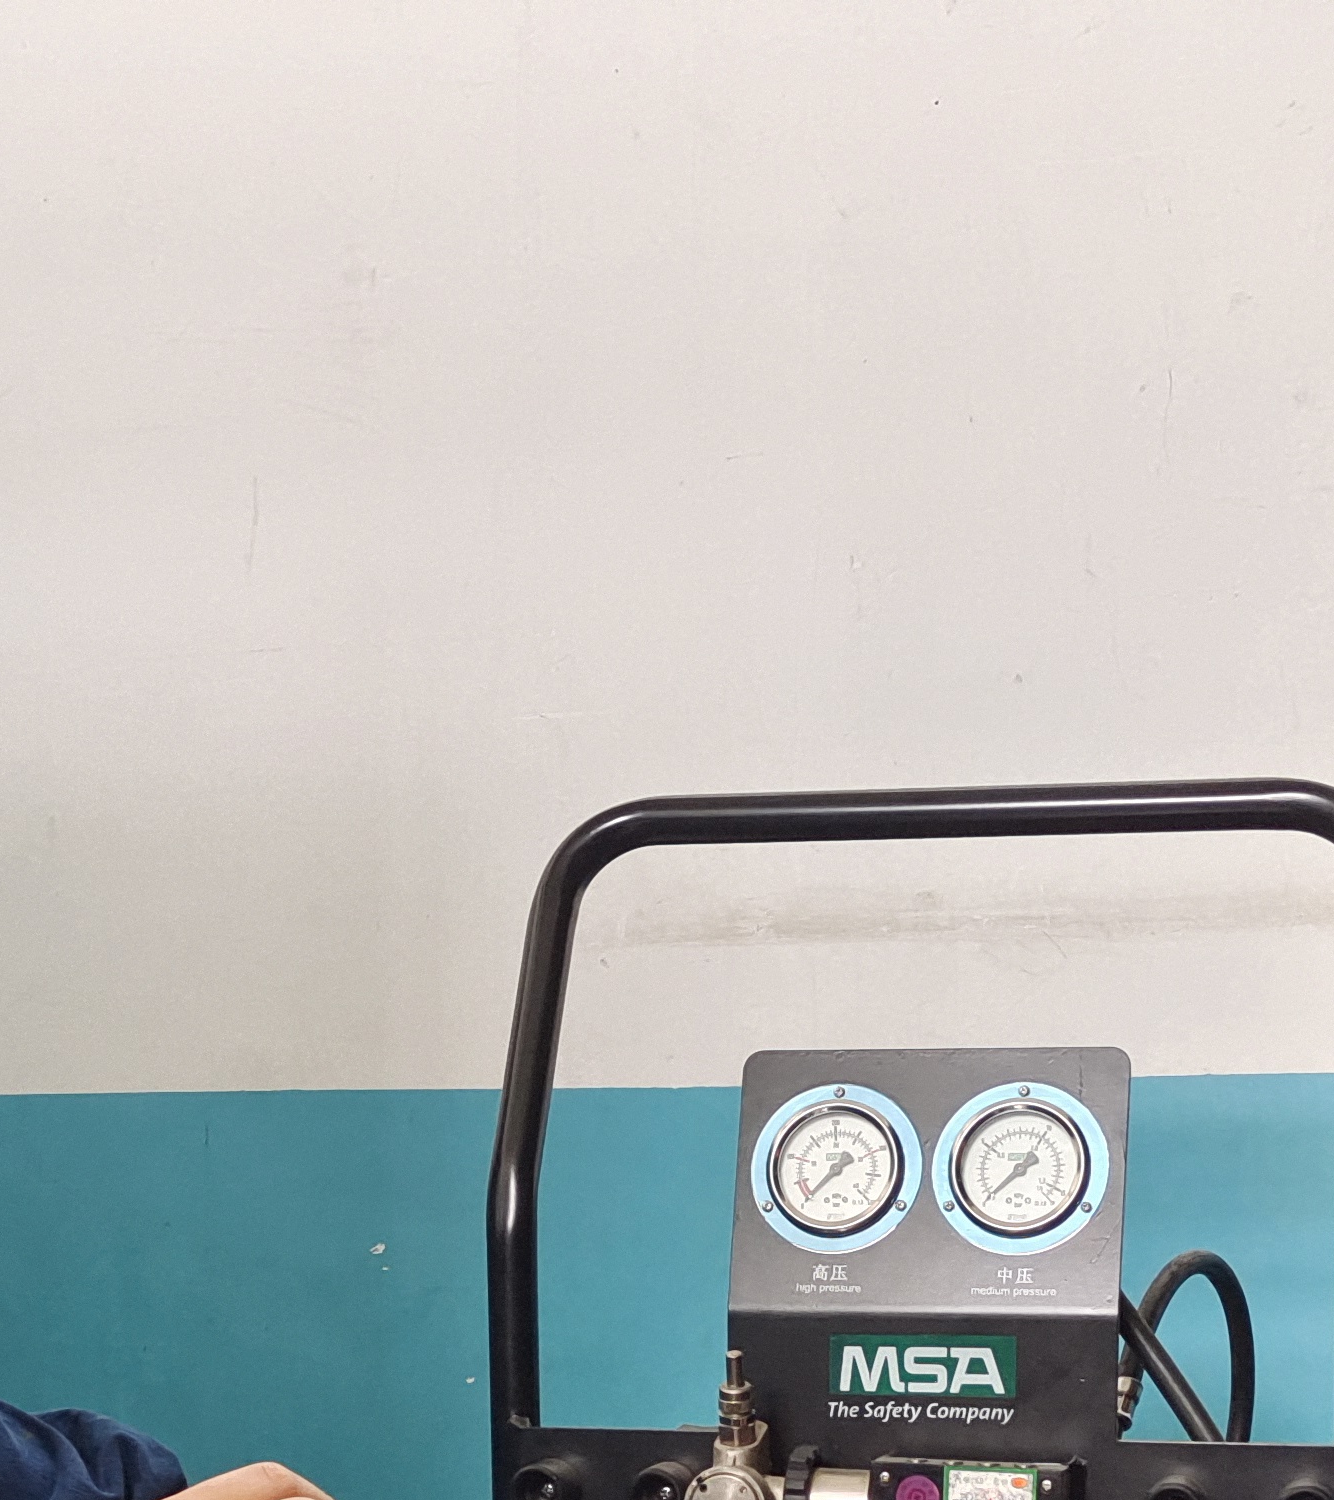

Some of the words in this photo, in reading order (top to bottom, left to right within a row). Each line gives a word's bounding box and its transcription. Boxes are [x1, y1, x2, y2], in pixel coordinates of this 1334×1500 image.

[812, 1264, 848, 1282] 高压
[998, 1267, 1034, 1285] 中压
[796, 1283, 817, 1294] high
[819, 1284, 862, 1295] pressure
[970, 1286, 1011, 1297] medium
[1013, 1287, 1058, 1299] pressure
[839, 1345, 1006, 1395] MSA
[827, 1401, 859, 1418] The
[864, 1400, 923, 1423] Safety
[926, 1402, 1015, 1425] Company
